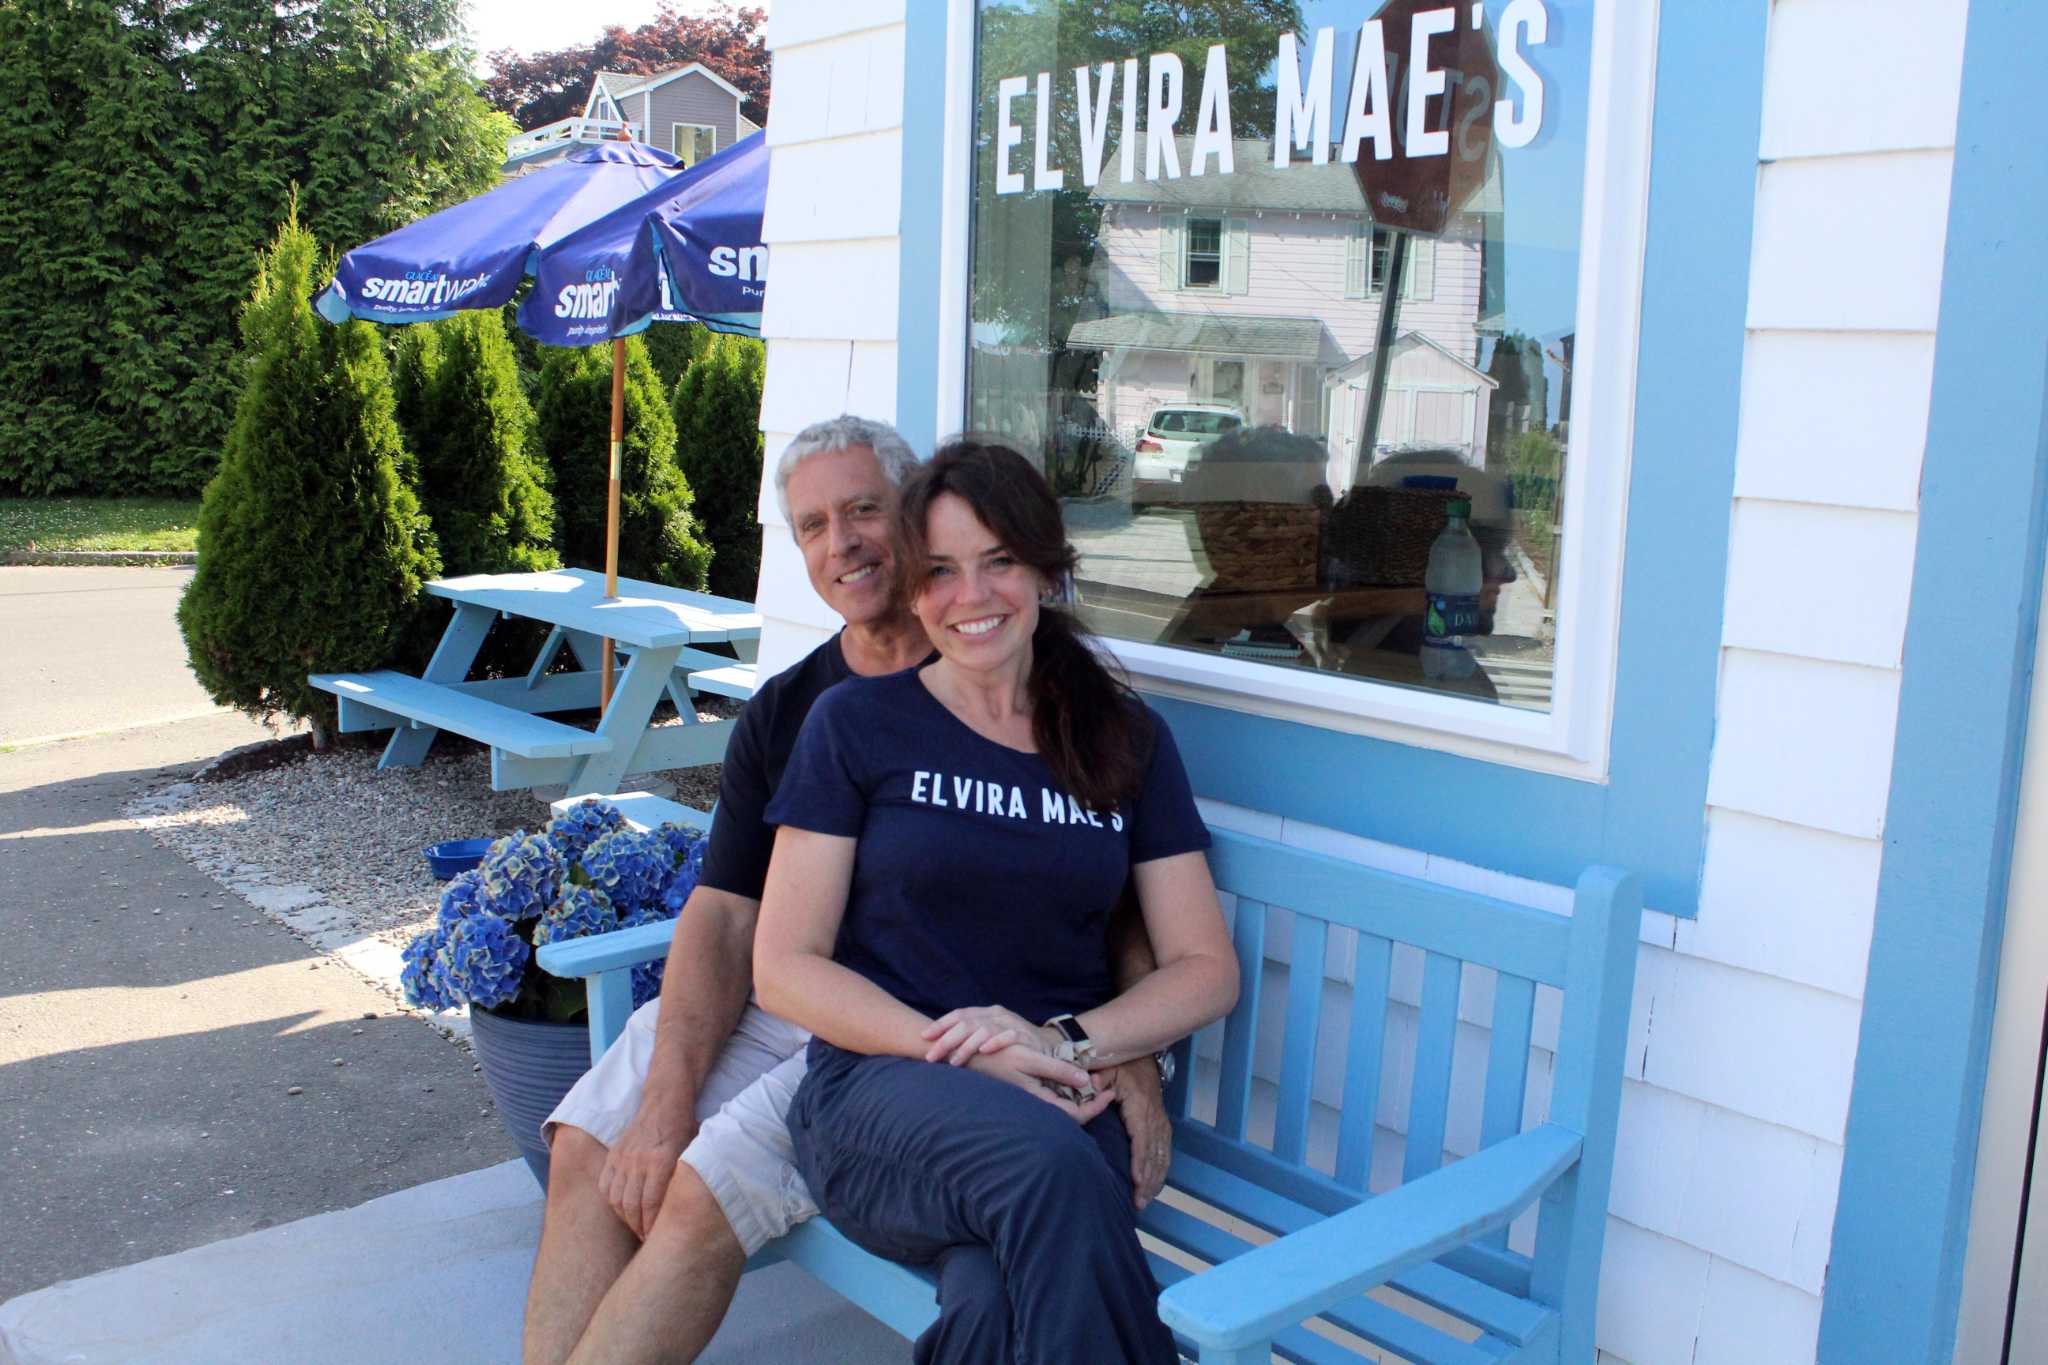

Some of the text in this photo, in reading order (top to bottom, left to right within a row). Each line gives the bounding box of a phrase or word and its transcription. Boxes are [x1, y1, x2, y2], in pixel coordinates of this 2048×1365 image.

[996, 0, 1547, 195] ELVIRA MAE'S
[911, 771, 1027, 819] ELVIRA
